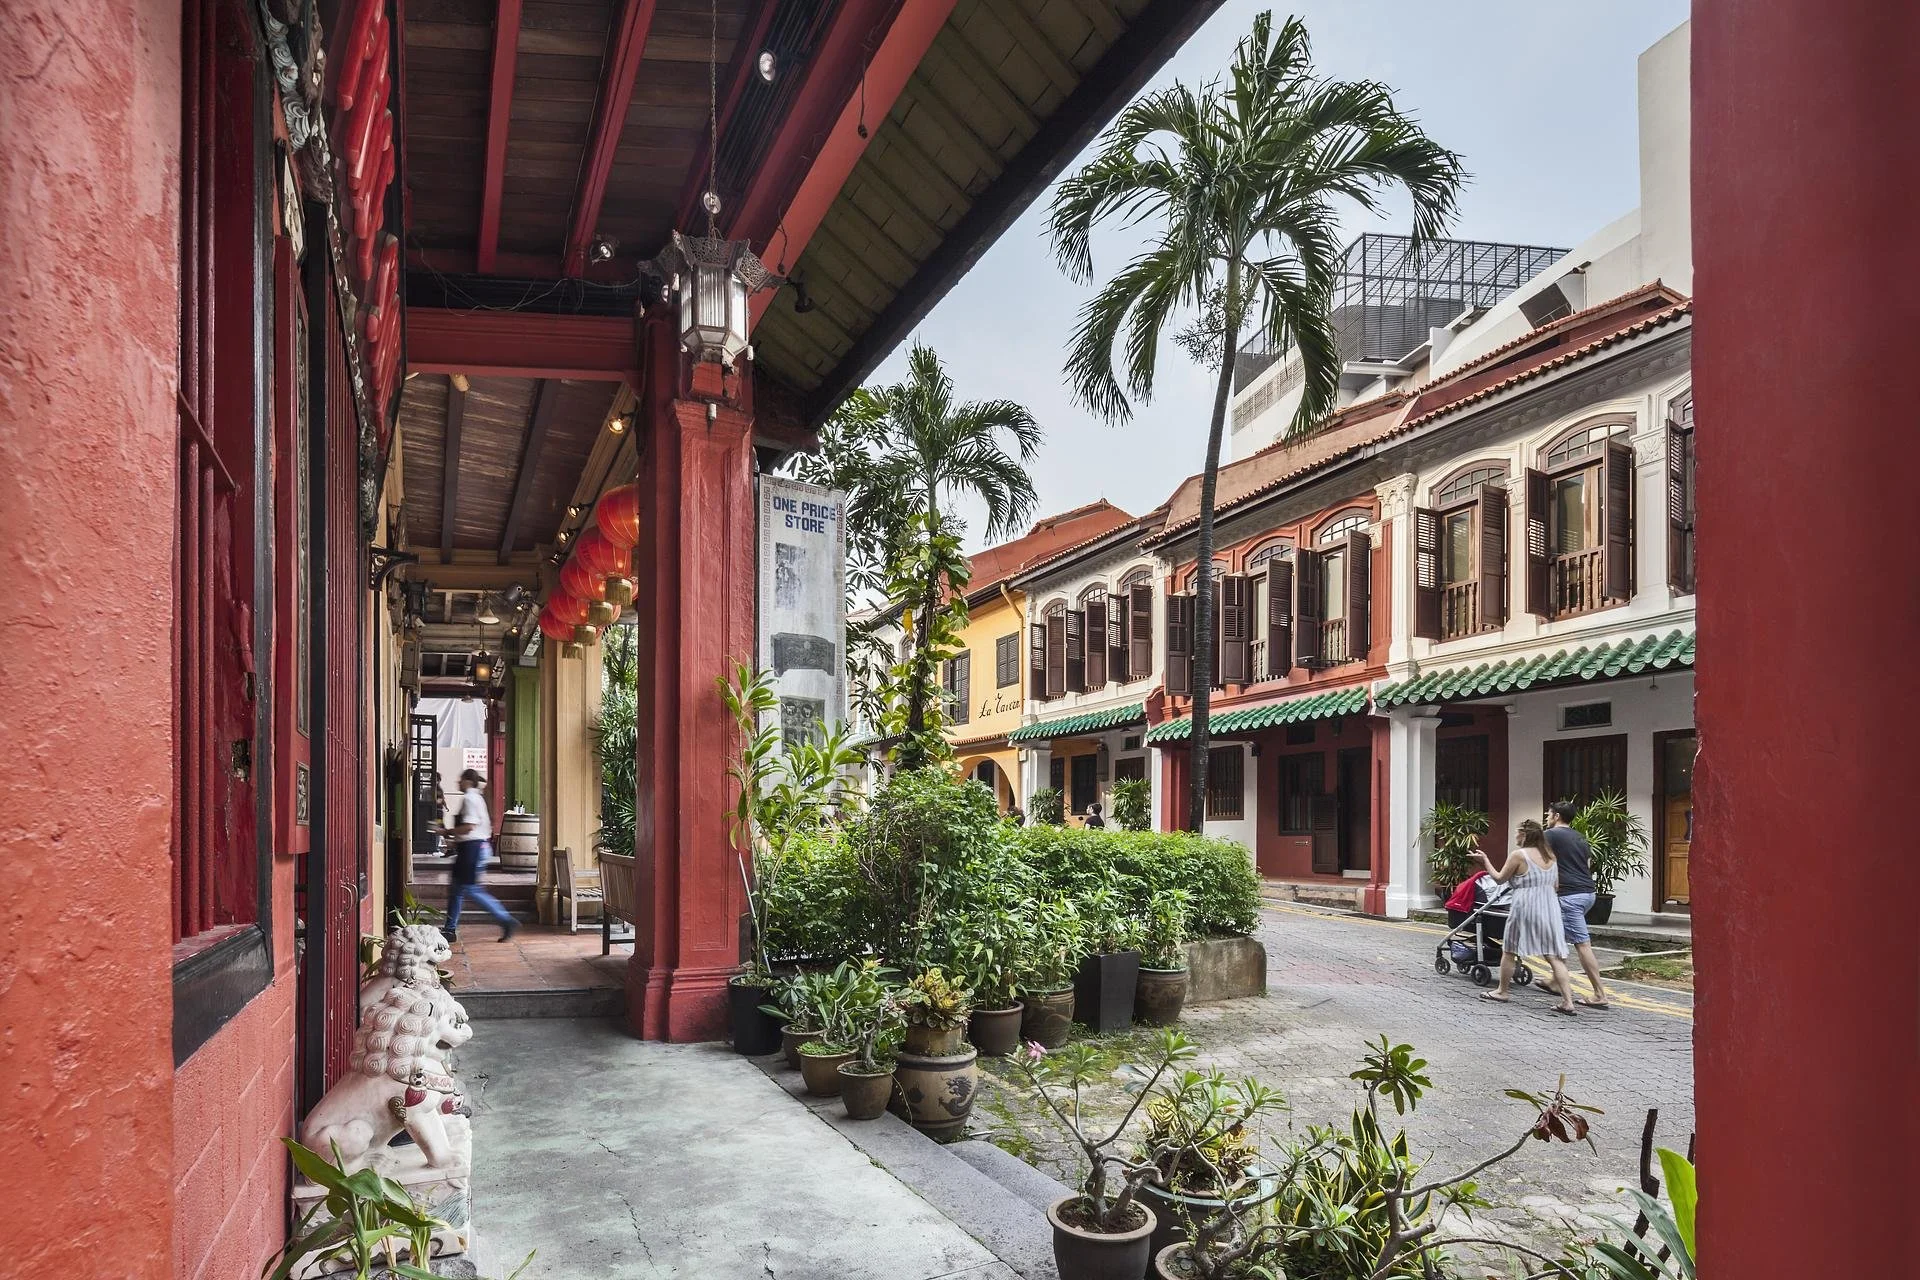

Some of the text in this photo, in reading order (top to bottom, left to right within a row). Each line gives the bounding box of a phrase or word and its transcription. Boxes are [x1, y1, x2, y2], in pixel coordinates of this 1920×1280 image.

[773, 496, 836, 521] ONE PRICE
[785, 514, 825, 533] STORE
[979, 699, 992, 718] La
